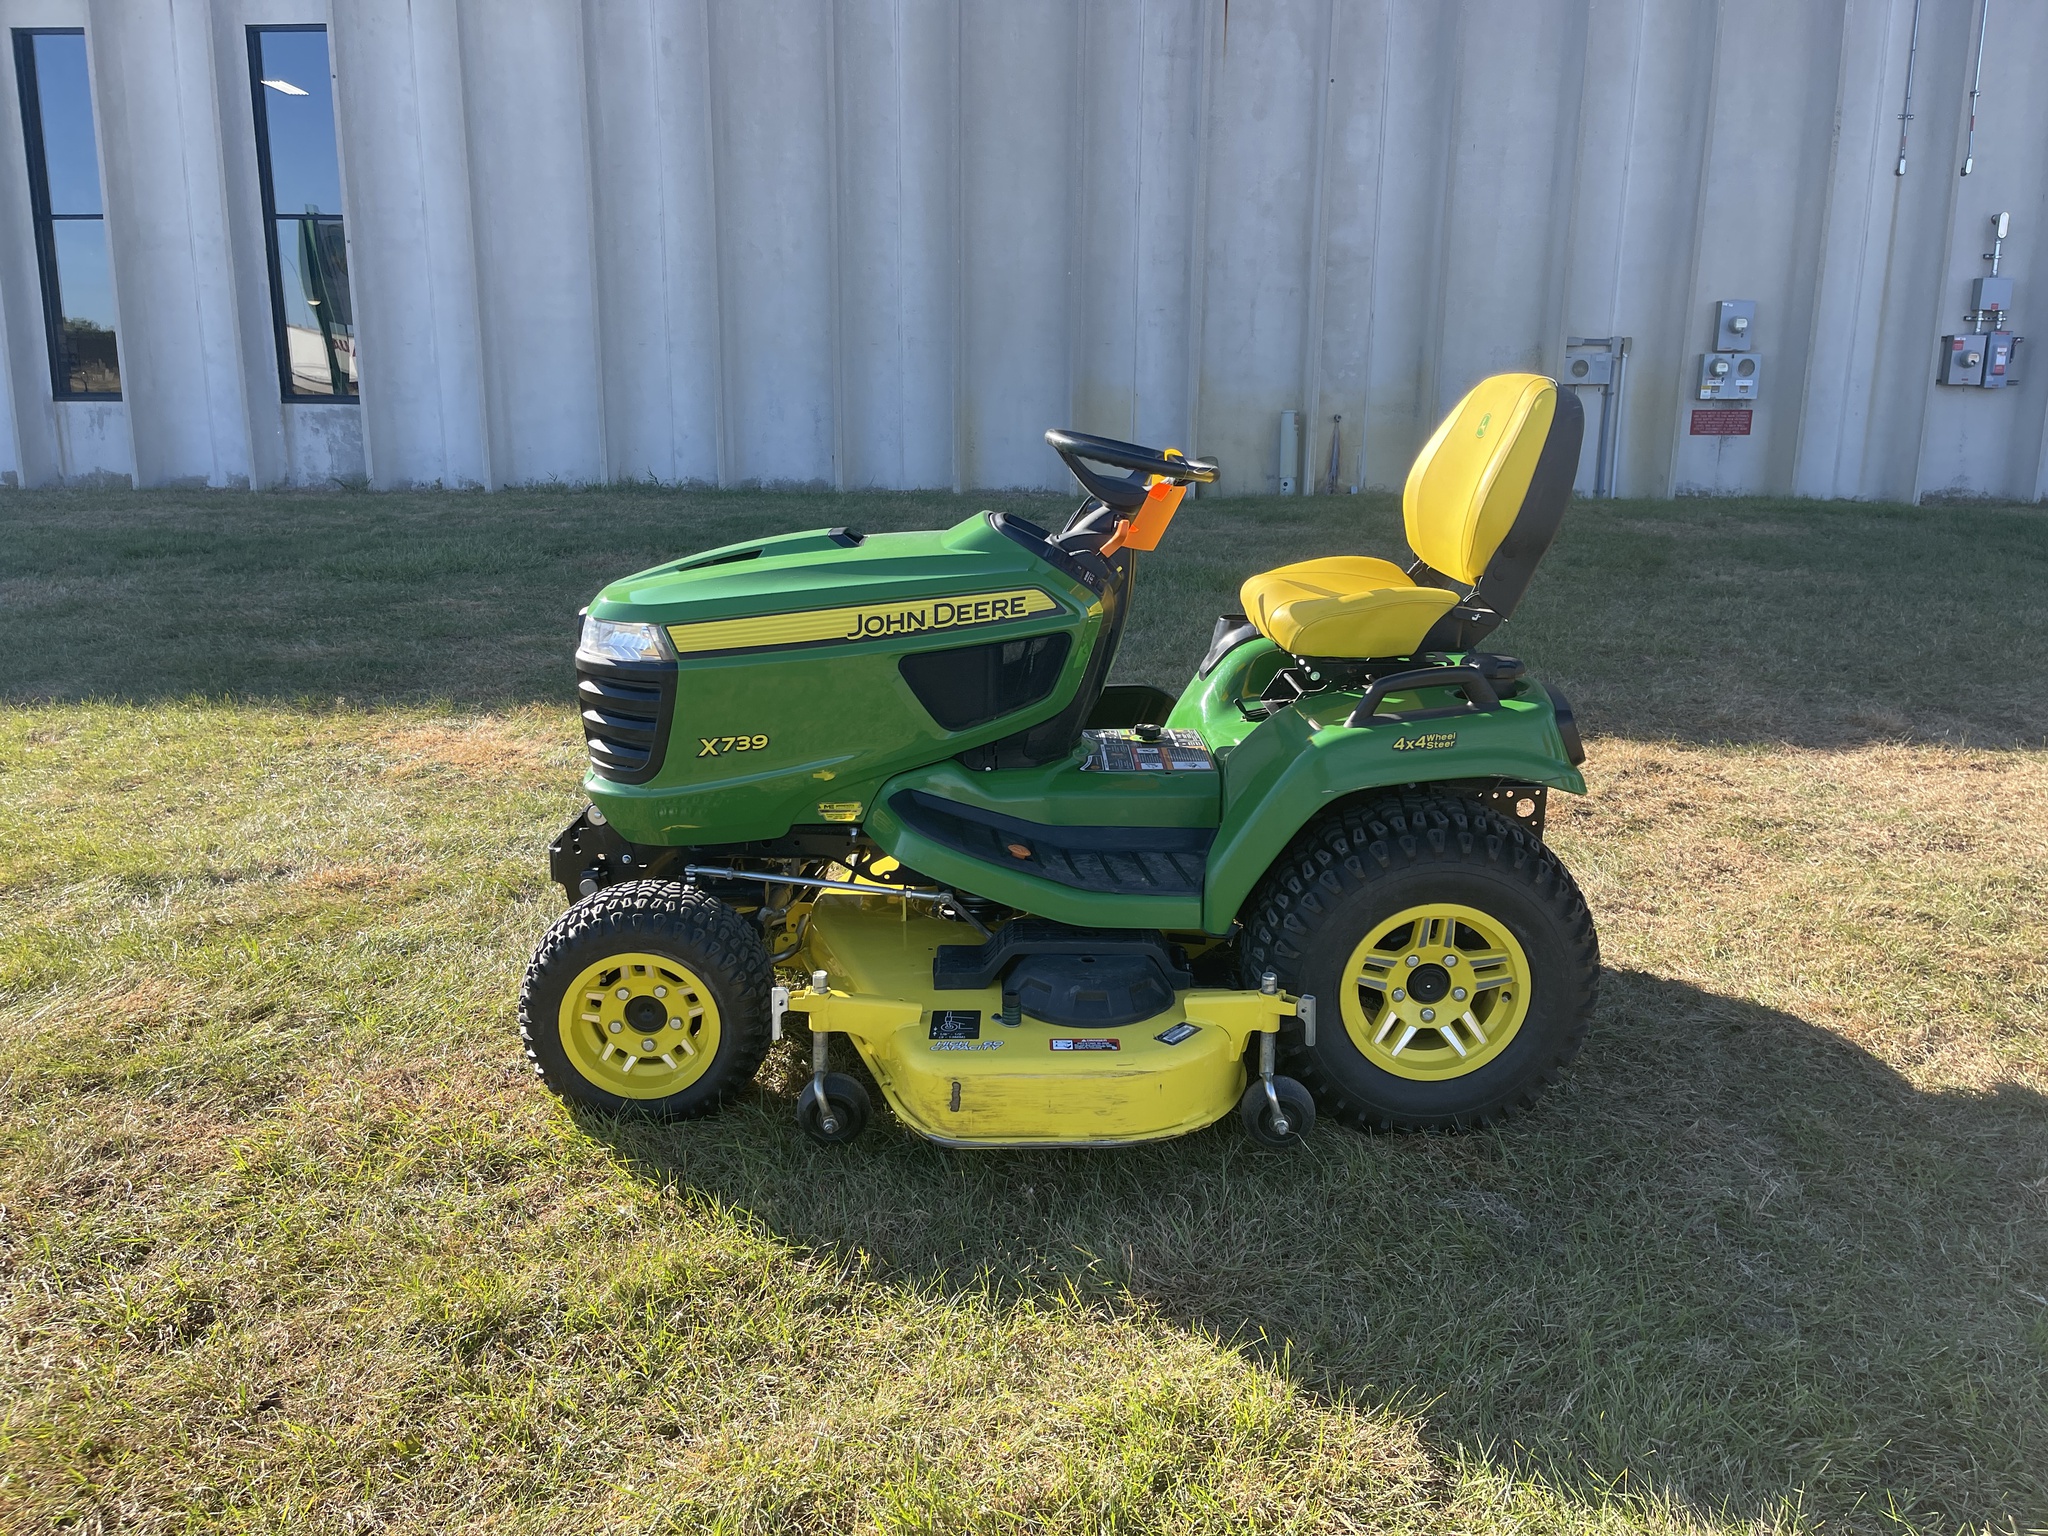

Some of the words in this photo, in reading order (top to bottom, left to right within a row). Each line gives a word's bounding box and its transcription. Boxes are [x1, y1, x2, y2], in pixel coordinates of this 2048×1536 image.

[847, 609, 926, 637] JOHN
[933, 596, 1027, 626] DEERE
[697, 734, 769, 757] X739
[1392, 735, 1426, 750] 4x4
[1426, 732, 1456, 741] Wheel
[1426, 741, 1455, 750] Steer
